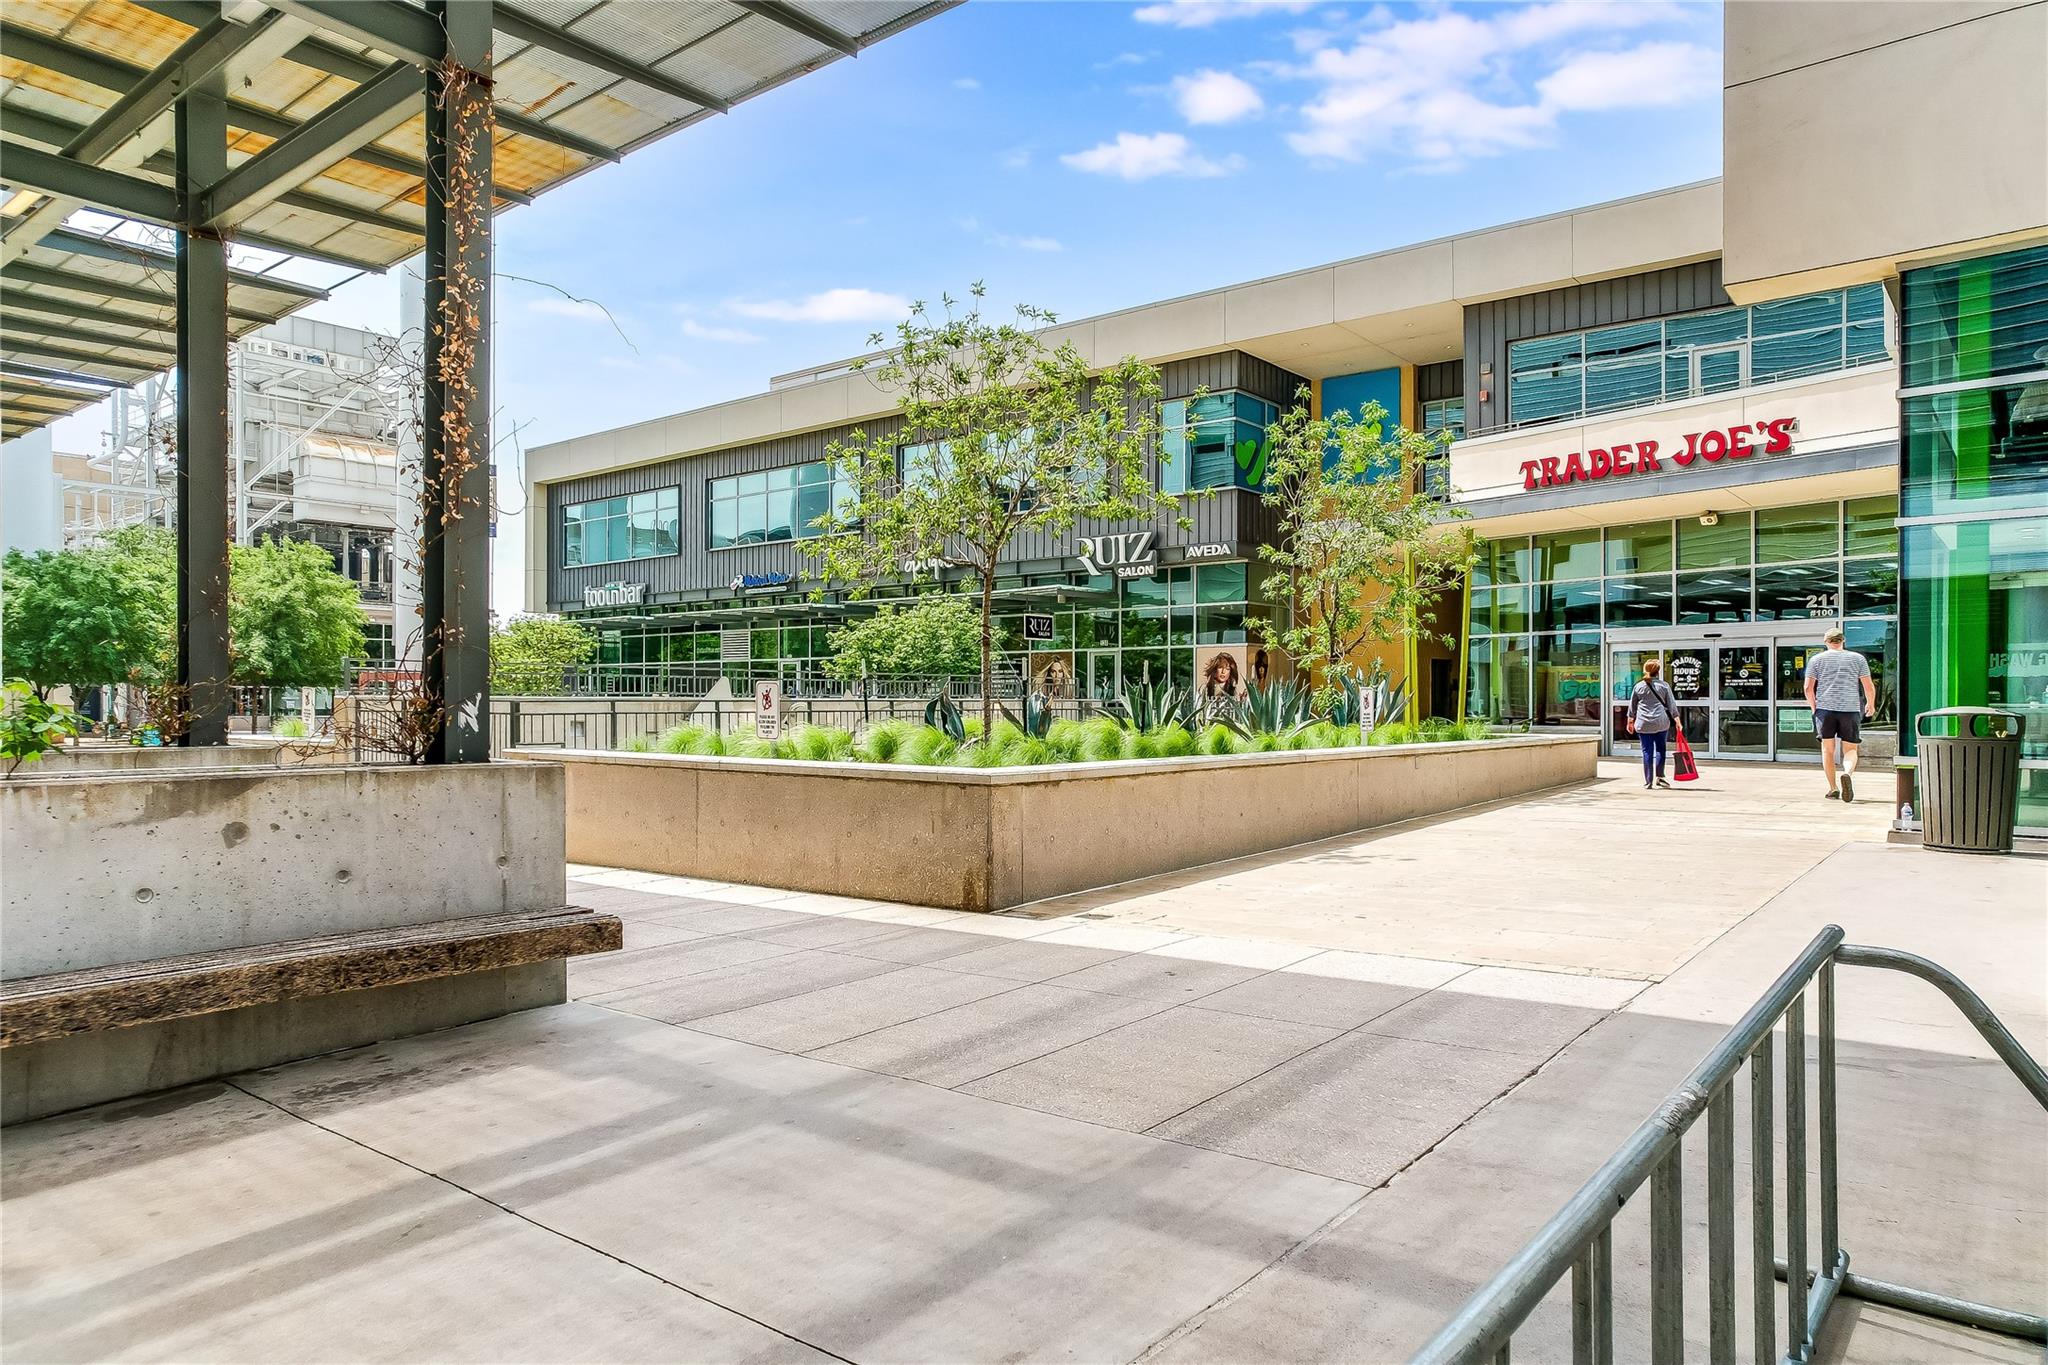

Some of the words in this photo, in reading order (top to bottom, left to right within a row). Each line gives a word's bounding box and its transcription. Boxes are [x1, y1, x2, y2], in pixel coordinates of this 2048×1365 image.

[1519, 440, 1662, 490] TRADER
[1671, 416, 1797, 467] JOE'S
[1075, 531, 1153, 575] RUIZ
[1186, 543, 1232, 558] AVEDA
[1117, 564, 1154, 577] SALON
[1805, 592, 1839, 608] 211
[1809, 608, 1834, 617] #100
[1029, 617, 1050, 634] RUIZ
[1671, 656, 1702, 668] TRADING
[1673, 667, 1700, 675] HOURS
